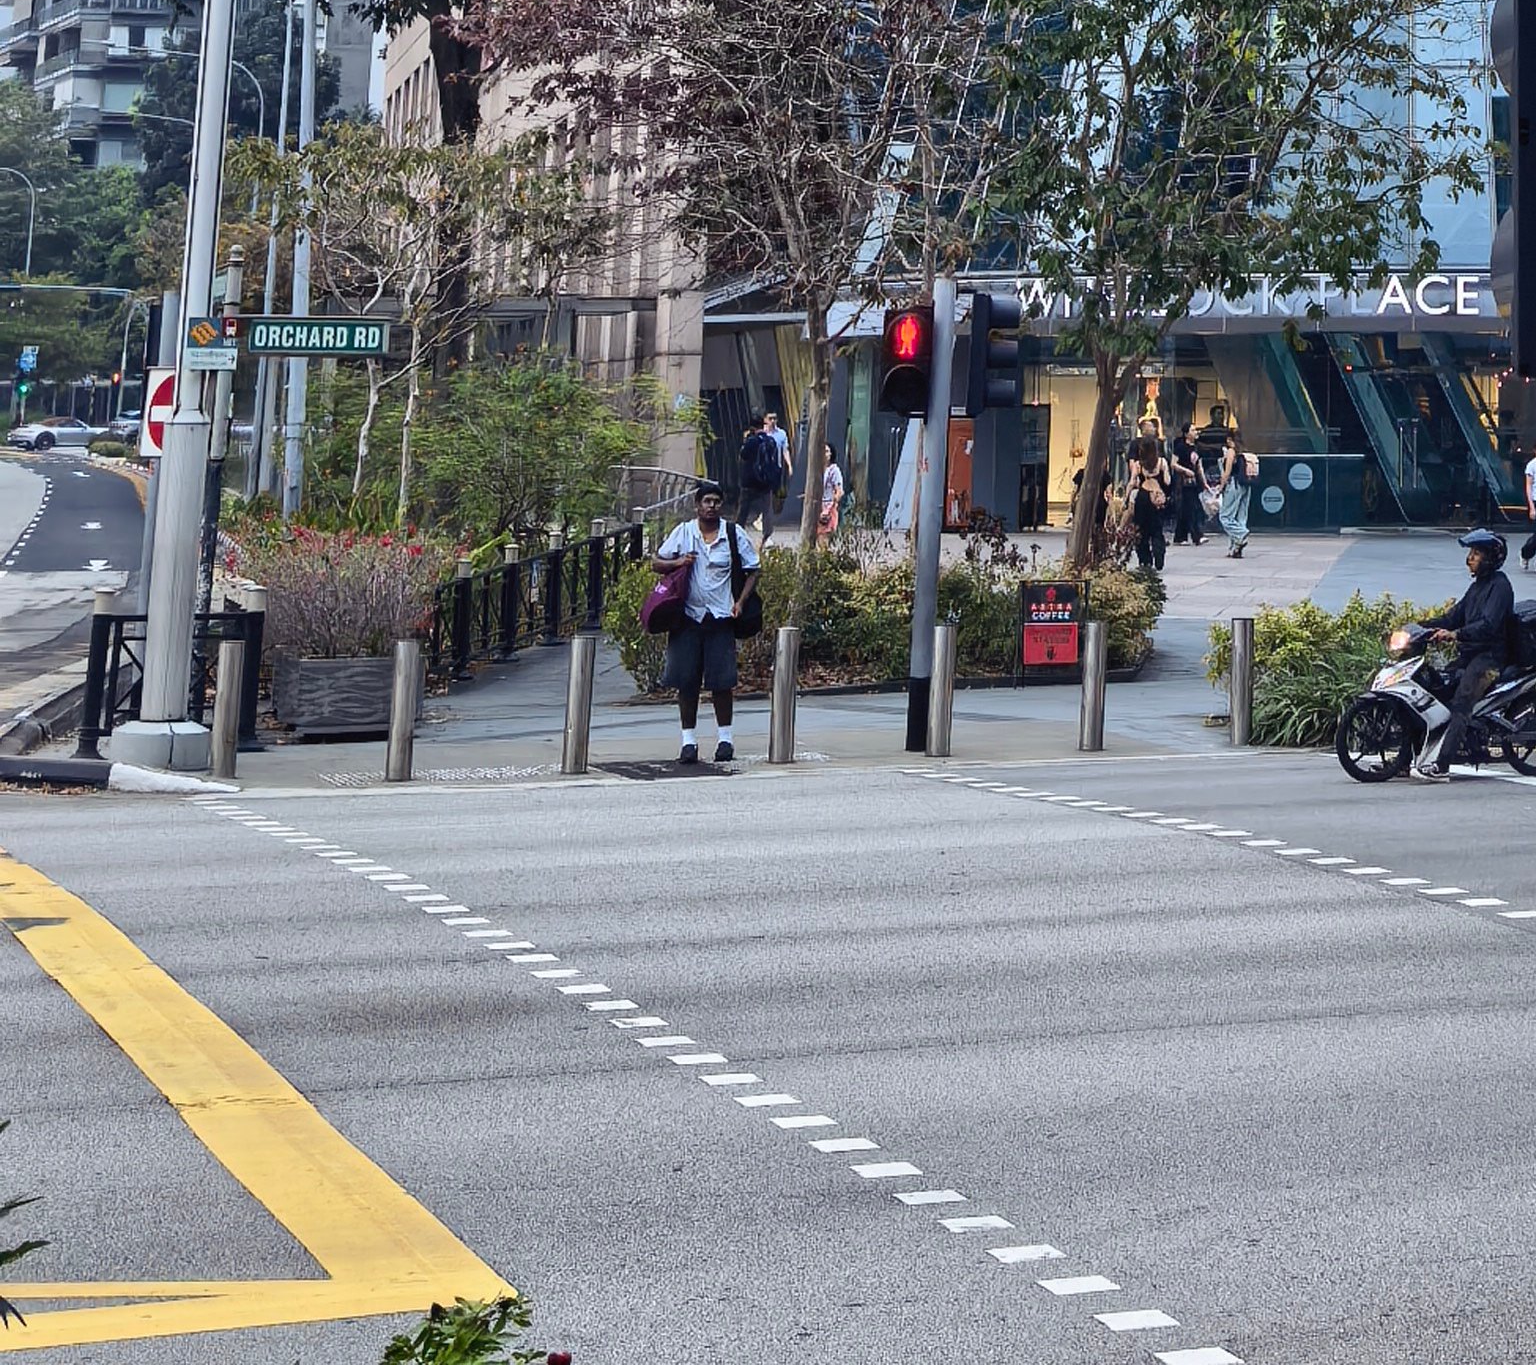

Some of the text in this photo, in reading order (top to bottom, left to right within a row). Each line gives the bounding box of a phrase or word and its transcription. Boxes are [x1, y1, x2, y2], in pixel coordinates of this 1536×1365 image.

[1320, 274, 1481, 316] PLACE
[255, 324, 381, 348] ORCHARD RD
[1031, 611, 1071, 620] COFFEE
